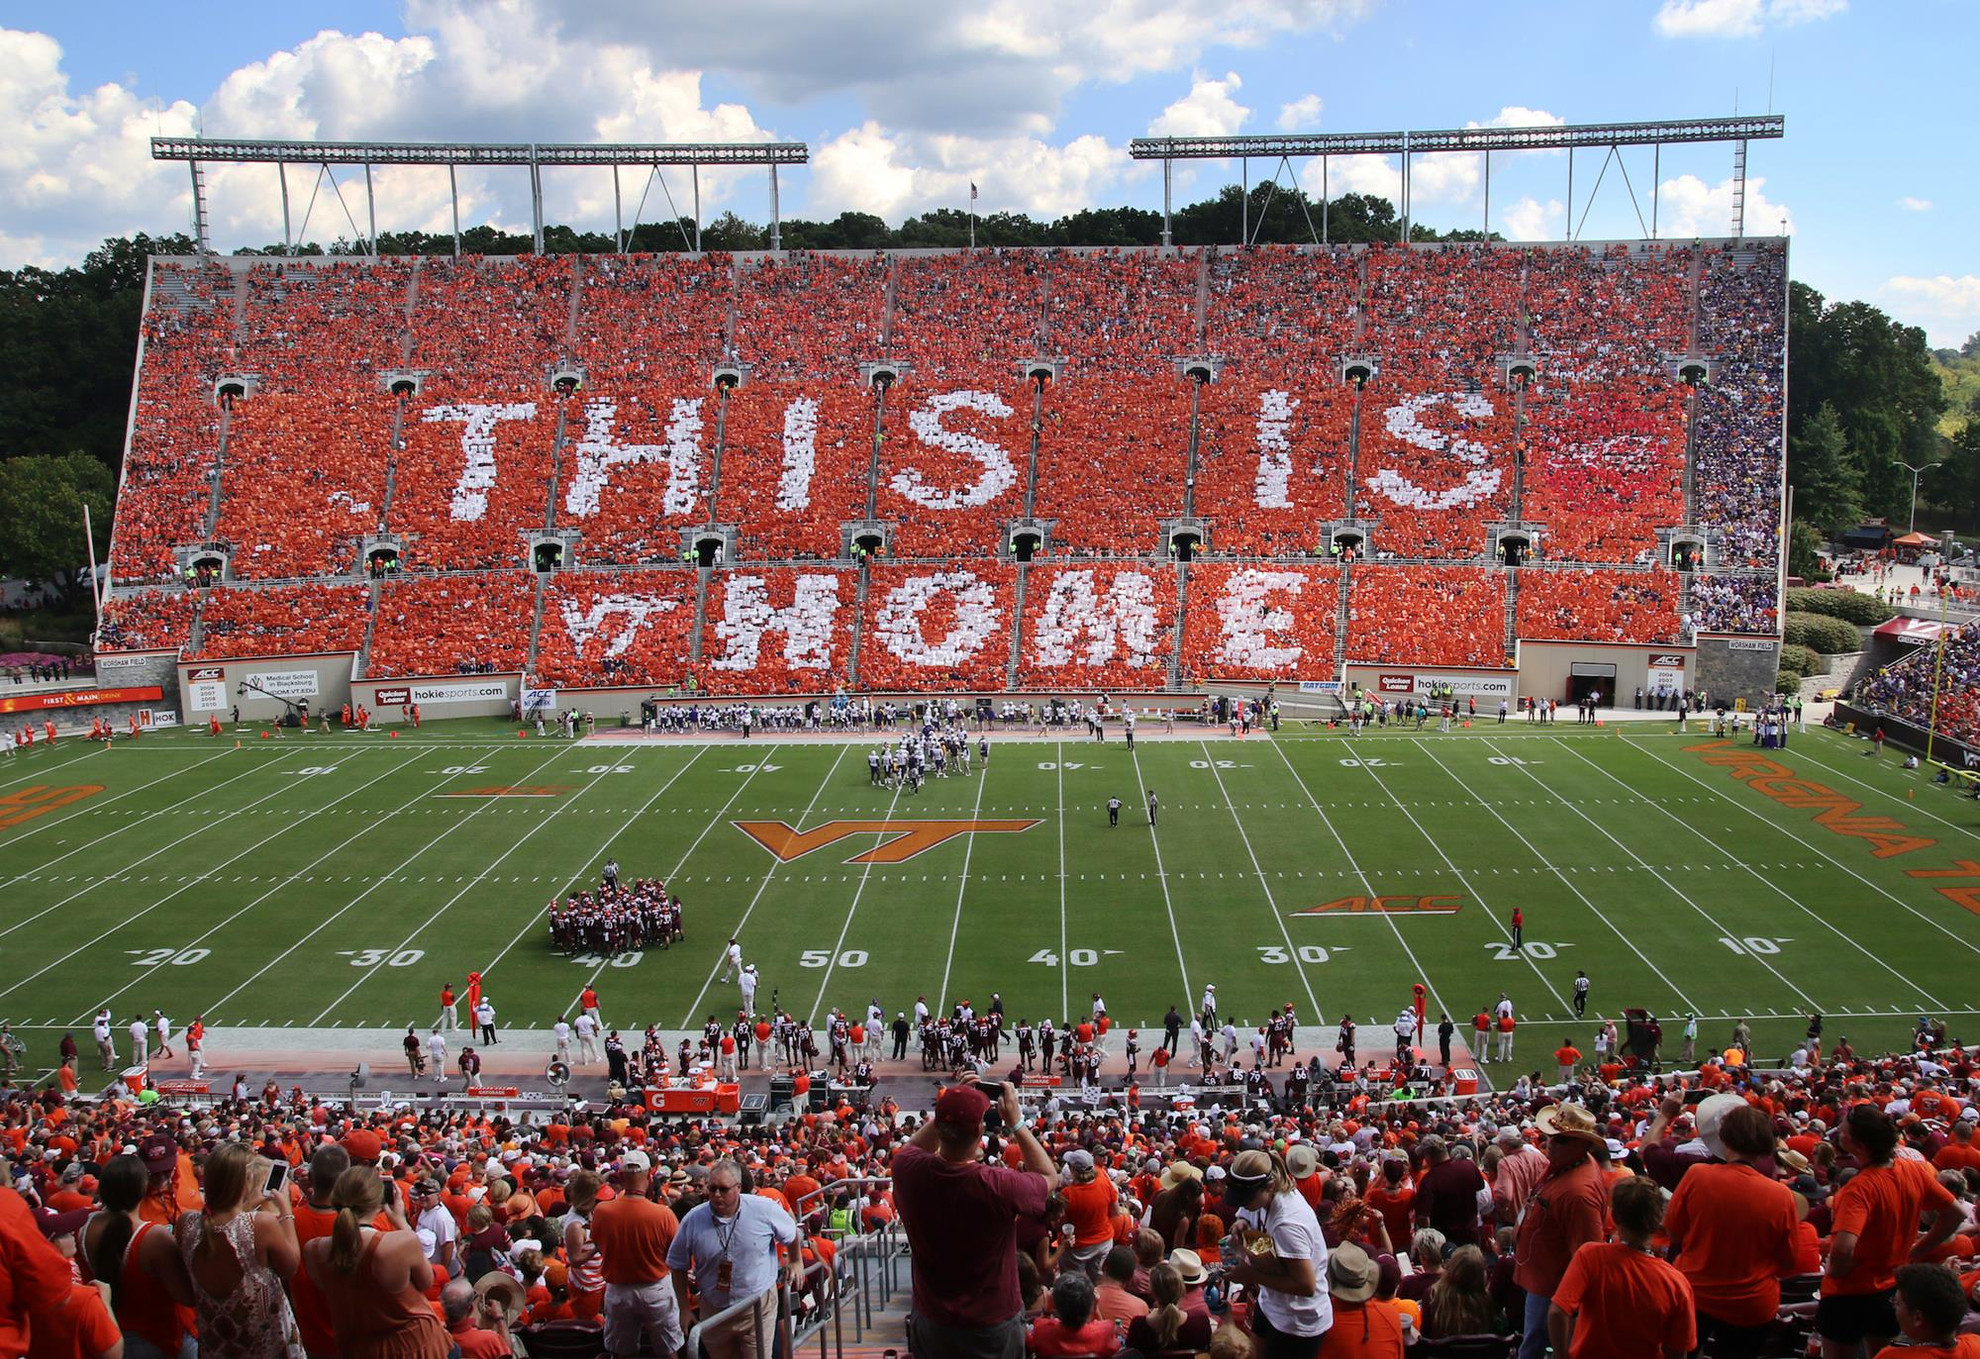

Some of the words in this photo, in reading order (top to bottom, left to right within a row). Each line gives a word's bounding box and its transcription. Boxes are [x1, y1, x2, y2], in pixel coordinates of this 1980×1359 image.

[422, 390, 1018, 521] THIS
[1254, 388, 1501, 510] IS
[713, 568, 1306, 671] HOME
[1757, 642, 1772, 650] FIELD
[1898, 635, 1926, 646] GEICO
[75, 653, 92, 666] 25
[130, 657, 145, 665] FIELD
[1653, 656, 1681, 666] ACC
[192, 669, 220, 679] ACC
[1418, 679, 1507, 692] hokiesports.com
[43, 697, 64, 705] FIRST
[65, 693, 76, 705] &
[77, 694, 98, 702] MAIN
[415, 687, 503, 700] hokiesports.com
[527, 690, 552, 698] ACC
[155, 713, 175, 722] HOK
[729, 819, 1046, 864] VT
[1290, 894, 1465, 915] ACC
[1484, 941, 1558, 960] 20
[1718, 937, 1781, 955] 10
[130, 948, 211, 965] 20
[350, 949, 425, 967] 30
[570, 951, 644, 968] 40
[800, 950, 869, 968] 50
[1027, 949, 1099, 966] 40
[1256, 946, 1329, 964] 30
[858, 1065, 868, 1077] 13
[1296, 1070, 1307, 1081] 66
[1421, 1068, 1431, 1078] 71
[1250, 1072, 1261, 1084] 79
[651, 1093, 666, 1108] G
[901, 1242, 910, 1253] 2
